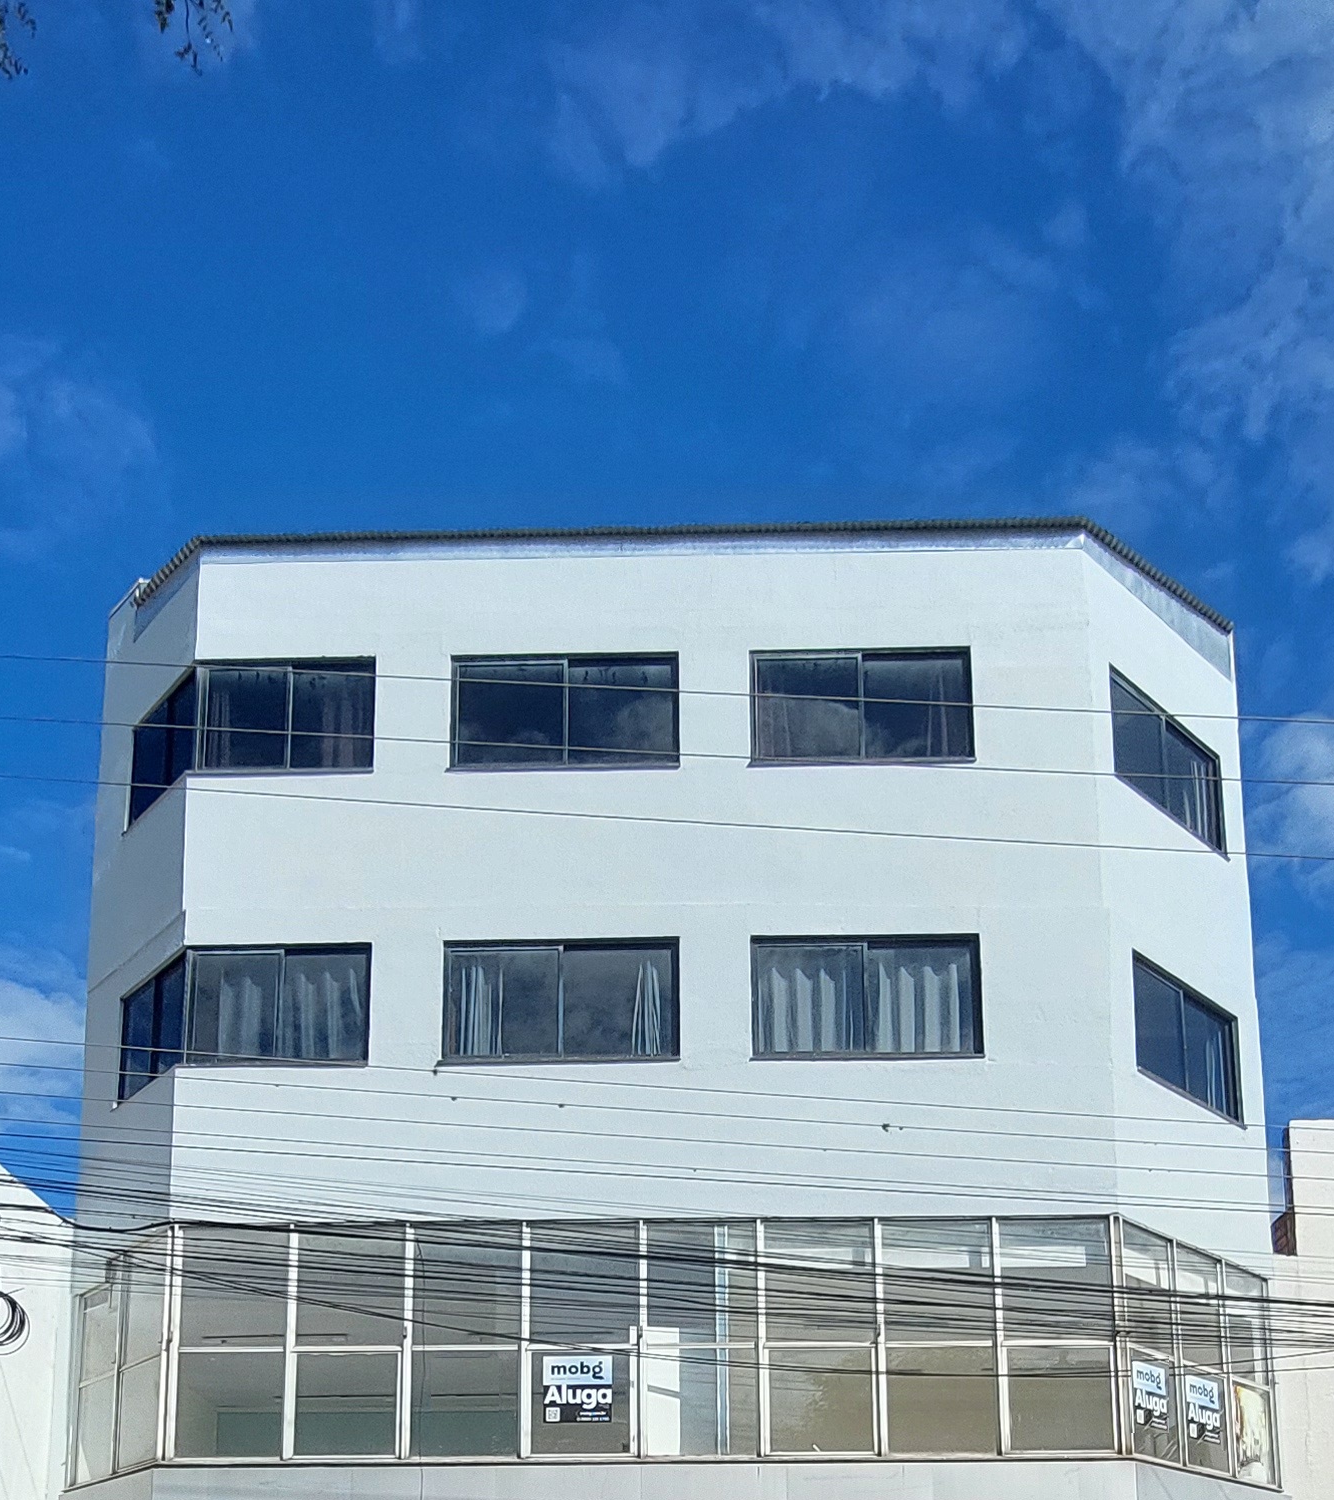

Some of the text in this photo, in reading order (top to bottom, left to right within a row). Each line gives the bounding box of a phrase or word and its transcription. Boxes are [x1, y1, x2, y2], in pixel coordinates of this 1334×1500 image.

[543, 1384, 613, 1410] Aluga
[1135, 1388, 1168, 1417] Aluga
[1187, 1402, 1221, 1431] Aluga
